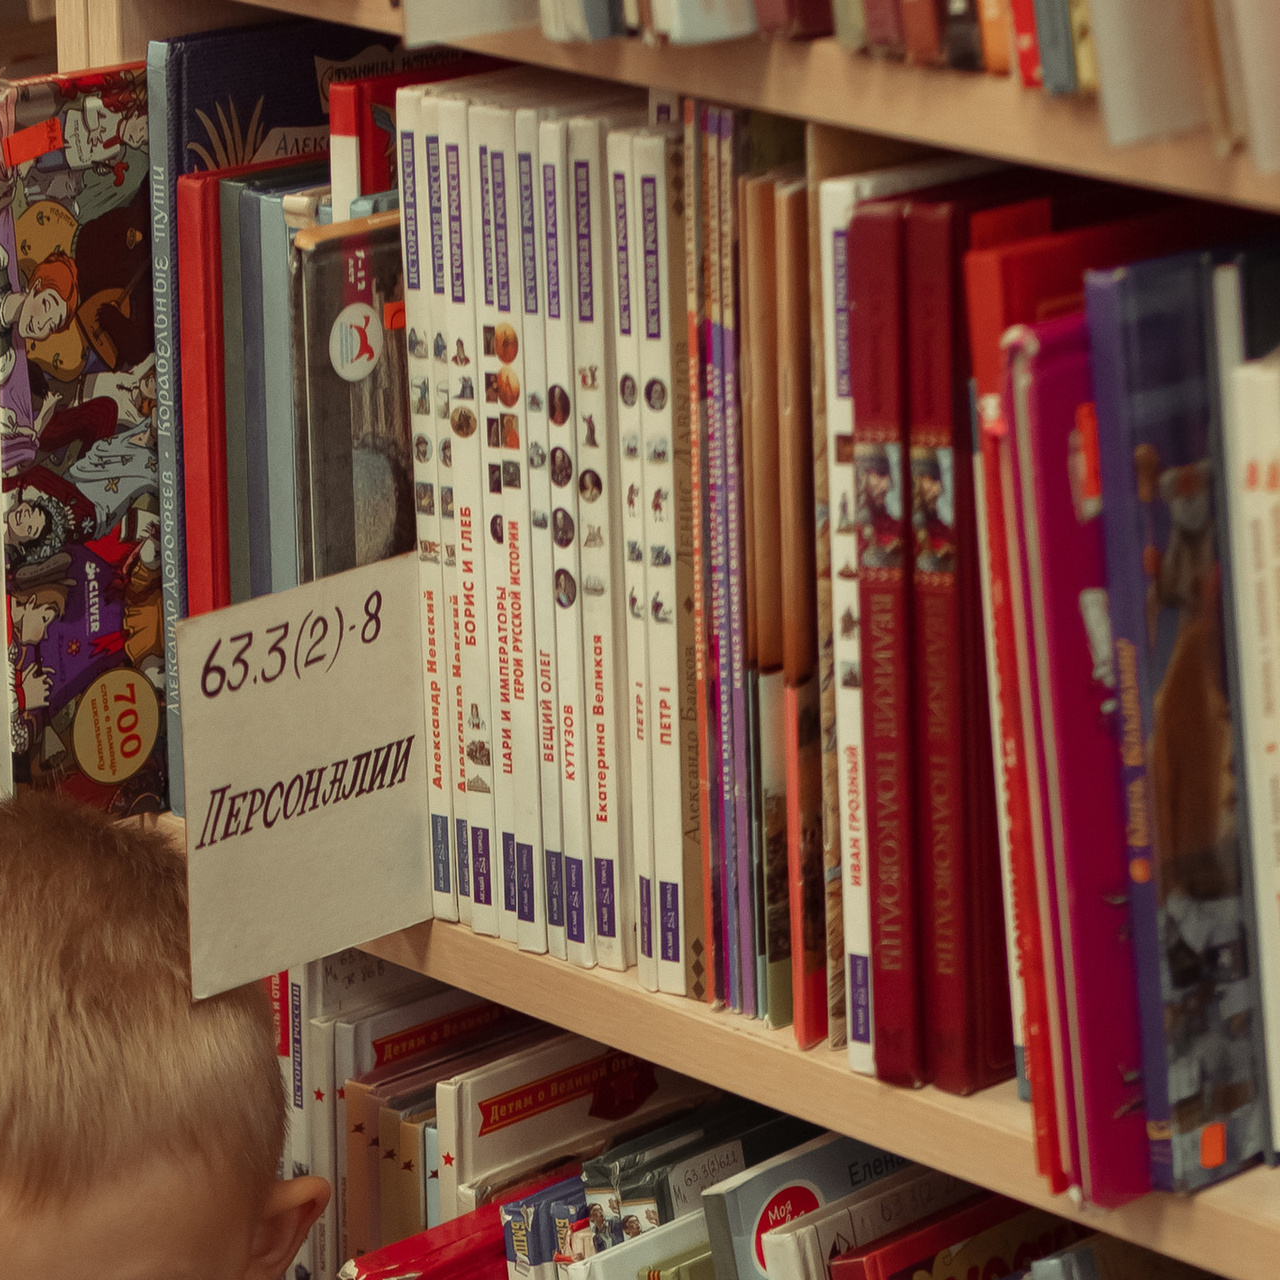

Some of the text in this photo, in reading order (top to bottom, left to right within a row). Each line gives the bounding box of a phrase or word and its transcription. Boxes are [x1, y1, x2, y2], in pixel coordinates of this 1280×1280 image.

[87, 580, 100, 633] CLEVER
[459, 506, 477, 647] БОРИС И ГЛЕБ
[508, 520, 525, 701] ГЕРОИ РУССКОЙ ИСТОРИИ
[114, 682, 143, 760] 700
[423, 590, 442, 791] Александр Невский
[496, 586, 513, 775] ЦАРИ И ИМПЕРАТОРЫ
[539, 650, 554, 763] ВЕЩИЙ ОЛЕГ
[592, 634, 609, 823] Екатерина Великая
[658, 698, 672, 746] ПЕТР
[195, 734, 416, 851] ПЕРСОНАЛИИ
[563, 704, 575, 781] КУТУЗОВ
[845, 746, 862, 887] ИВАН ГРОЗНЫЙ
[292, 985, 303, 1108] ИСТОРИЯ РОССИИ
[490, 1097, 534, 1123] Детям
[767, 1200, 793, 1226] Моя
